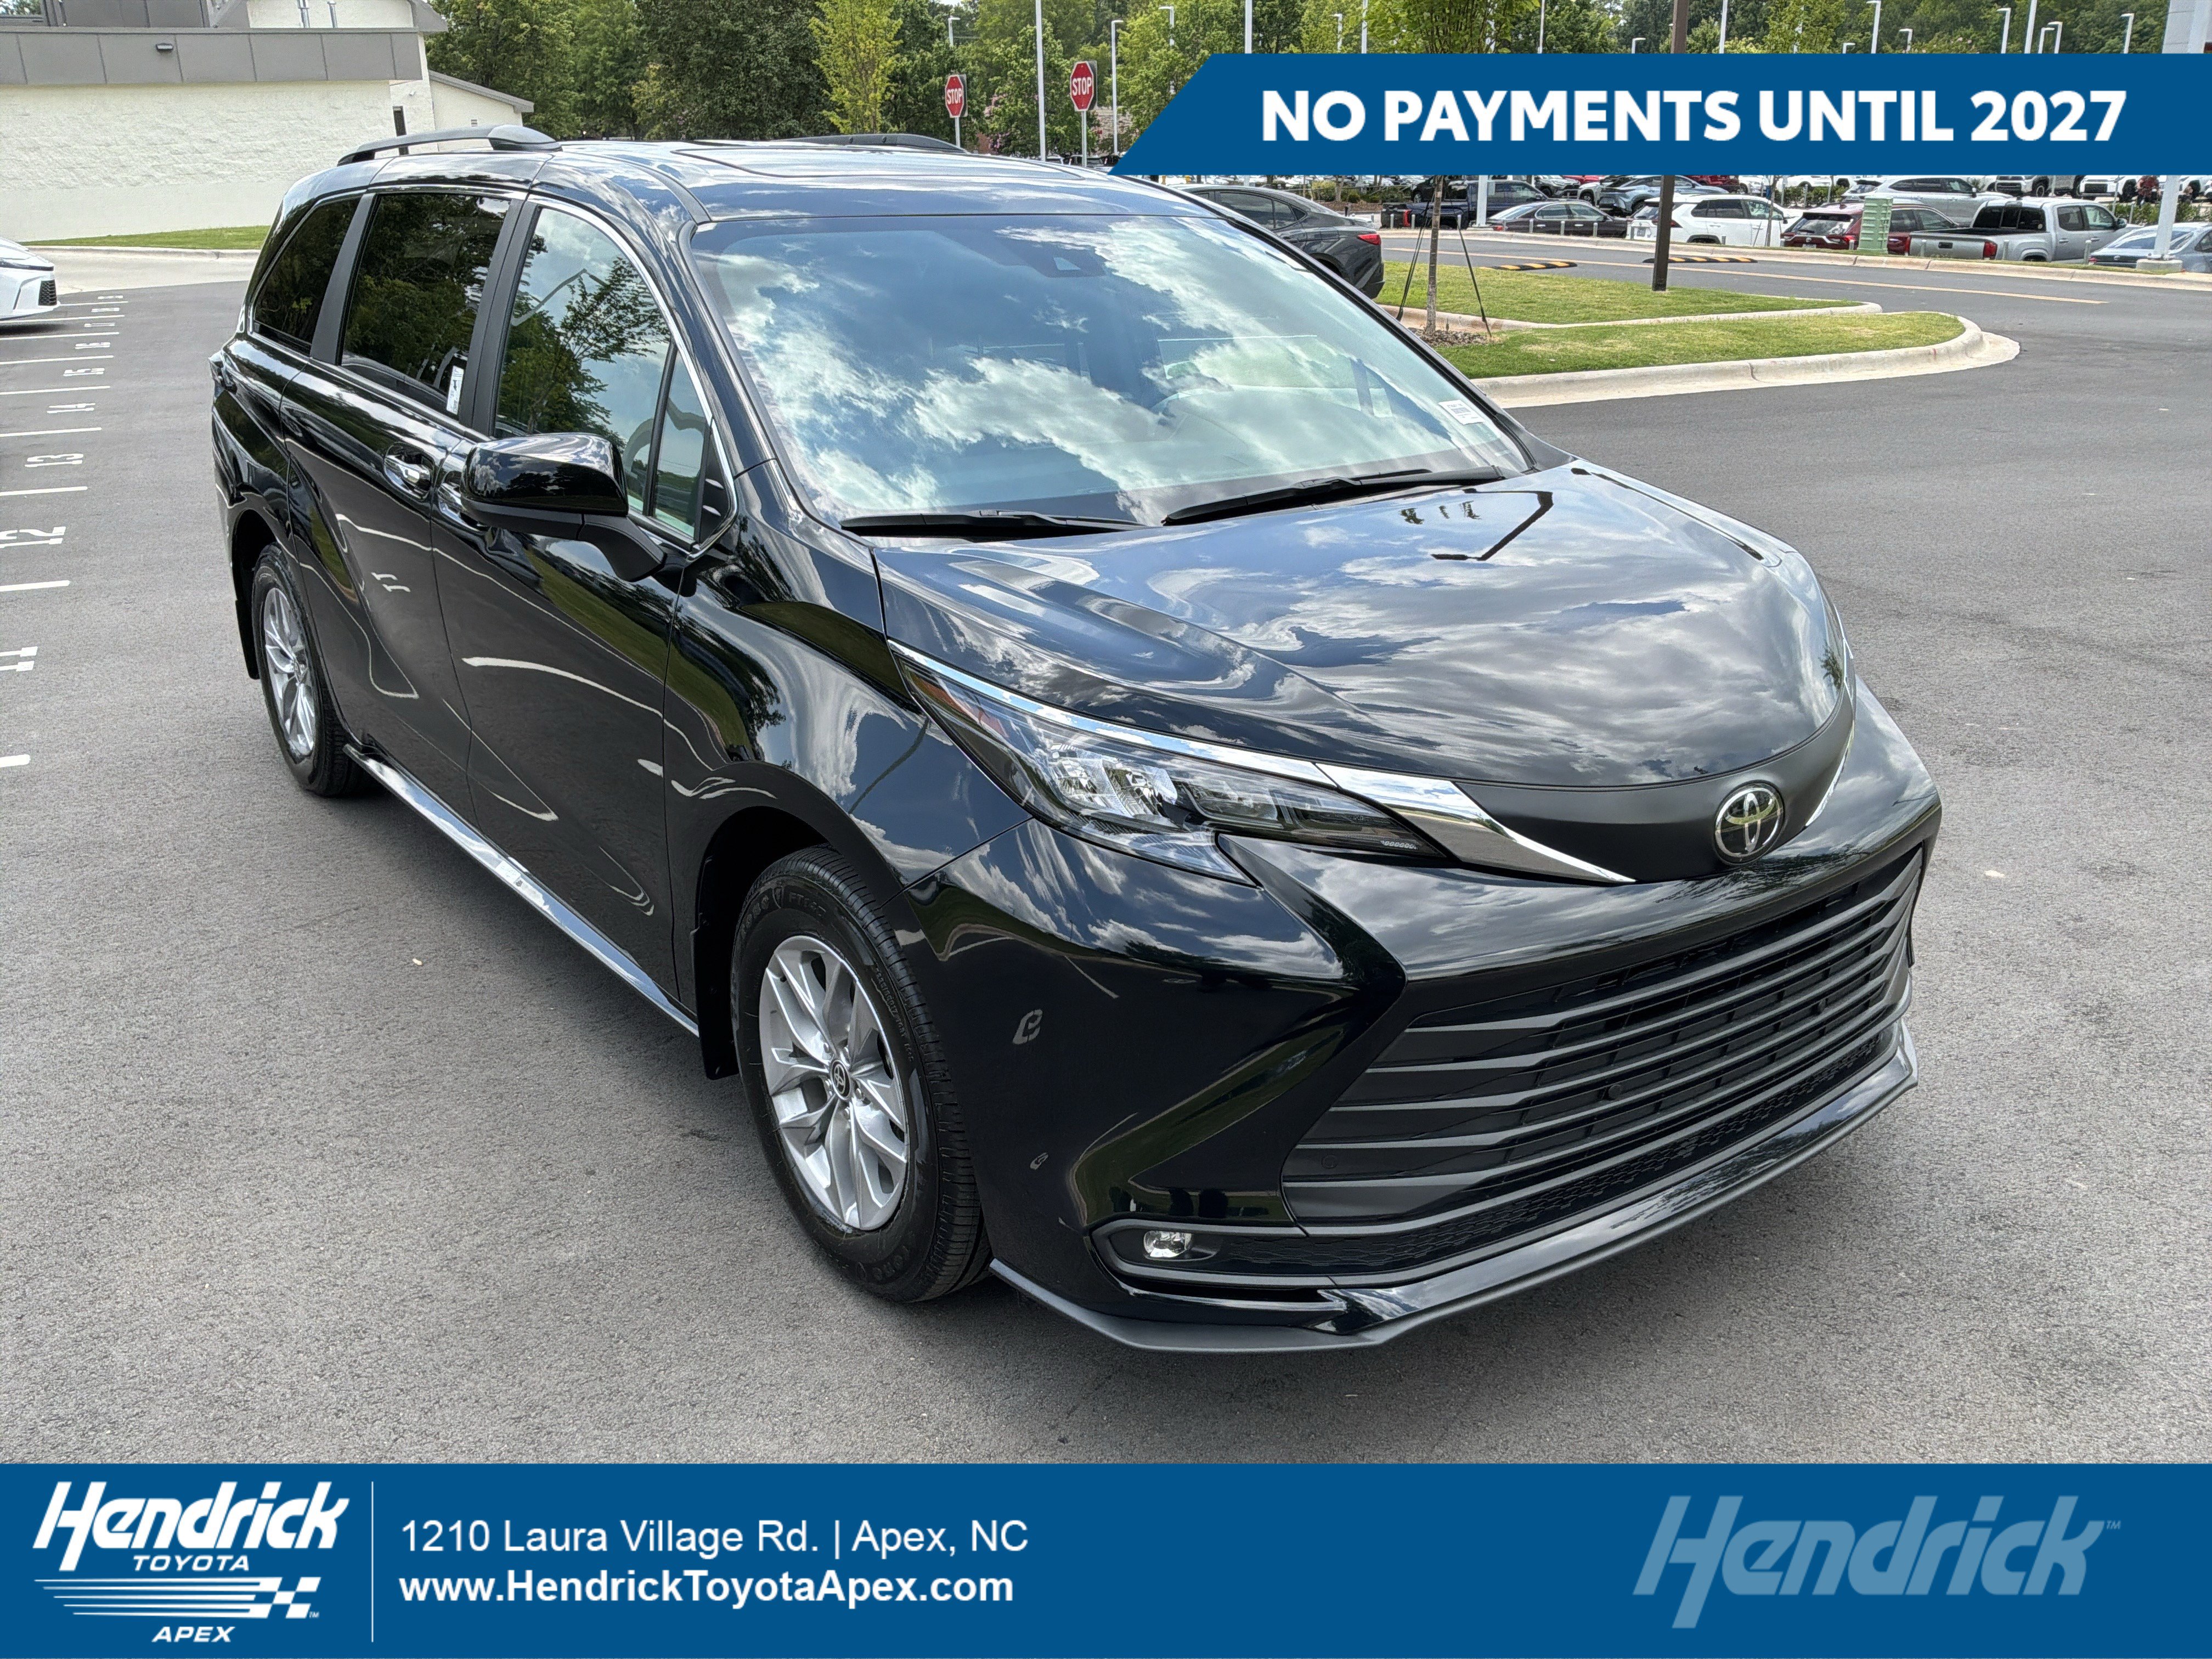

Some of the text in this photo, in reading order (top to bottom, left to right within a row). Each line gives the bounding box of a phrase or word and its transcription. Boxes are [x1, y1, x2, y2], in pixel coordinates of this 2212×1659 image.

[1072, 77, 1092, 96] STOP
[946, 88, 962, 105] STOP
[47, 403, 96, 414] 14
[24, 453, 84, 467] 13
[0, 526, 66, 549] 12
